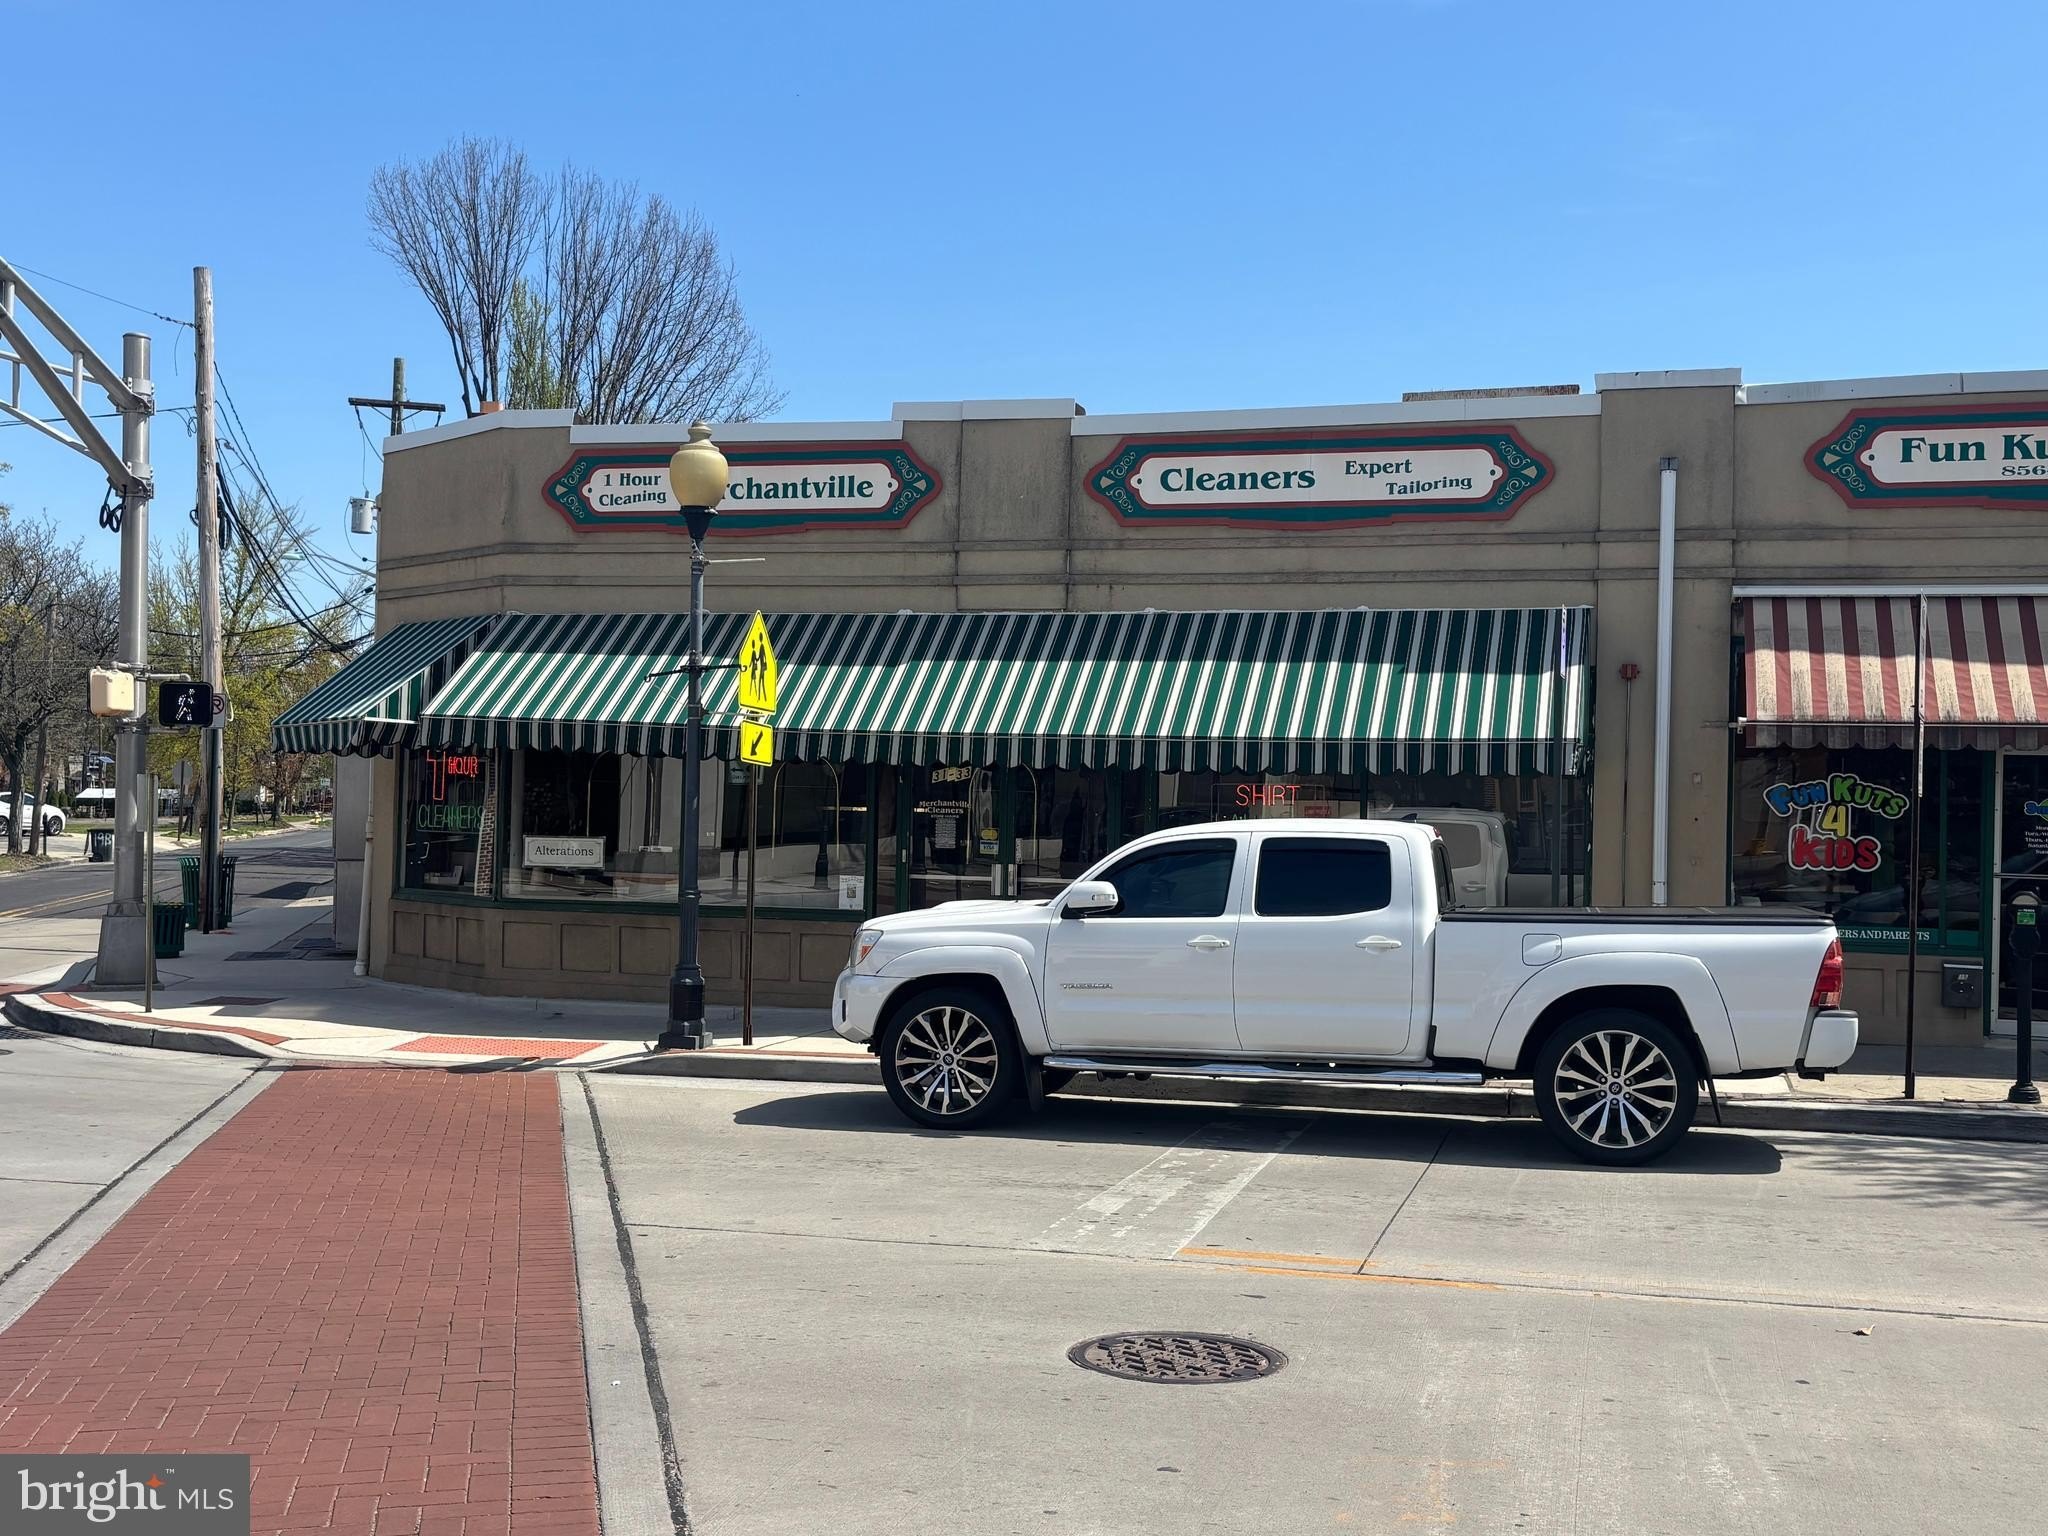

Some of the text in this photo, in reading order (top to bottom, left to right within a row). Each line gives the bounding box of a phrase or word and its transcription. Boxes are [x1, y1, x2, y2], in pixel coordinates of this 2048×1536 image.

[1900, 437, 1987, 463] Fun
[603, 472, 662, 487] 1 Hour
[1159, 466, 1316, 493] Cleaners
[1344, 459, 1413, 479] Expert
[1385, 475, 1473, 498] Tailoring
[598, 490, 667, 507] Cleaning
[447, 756, 479, 775] HOUR
[1235, 784, 1301, 806] SHIRT
[1764, 774, 1908, 818] FUN KUTS
[418, 803, 484, 829] CLEANERS
[927, 806, 964, 814] Cleaners
[1818, 804, 1849, 837] 4
[534, 845, 594, 856] Alterations
[1859, 930, 1882, 939] AND
[1883, 930, 1930, 941] PARETS
